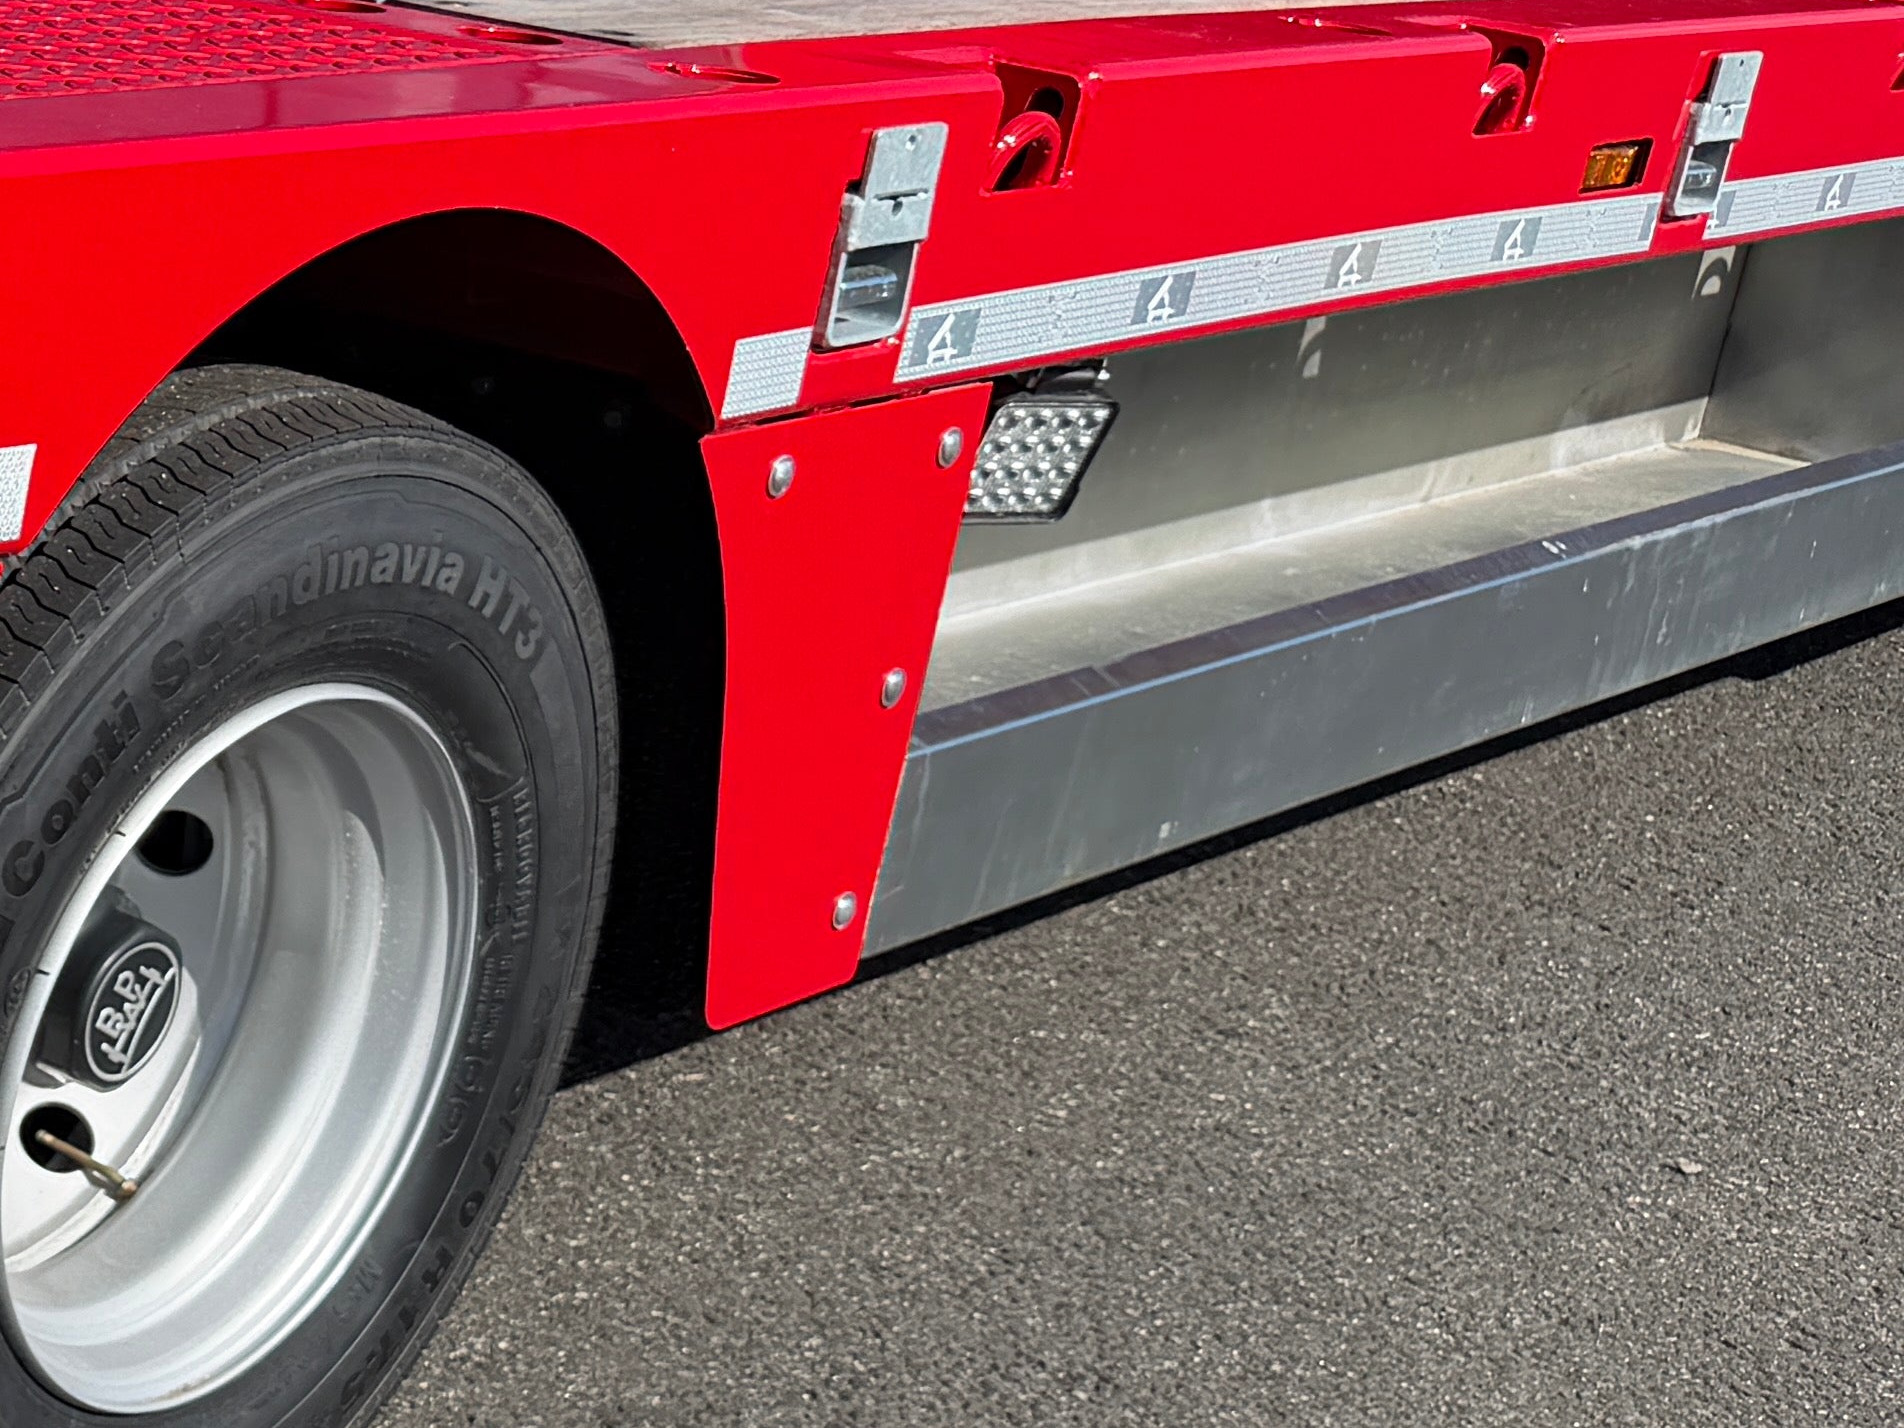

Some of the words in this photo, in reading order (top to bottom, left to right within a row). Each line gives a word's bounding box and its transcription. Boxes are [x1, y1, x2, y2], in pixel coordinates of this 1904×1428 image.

[1, 691, 142, 899] Conti
[150, 540, 466, 703] Scandinavia
[473, 564, 546, 659] HT3
